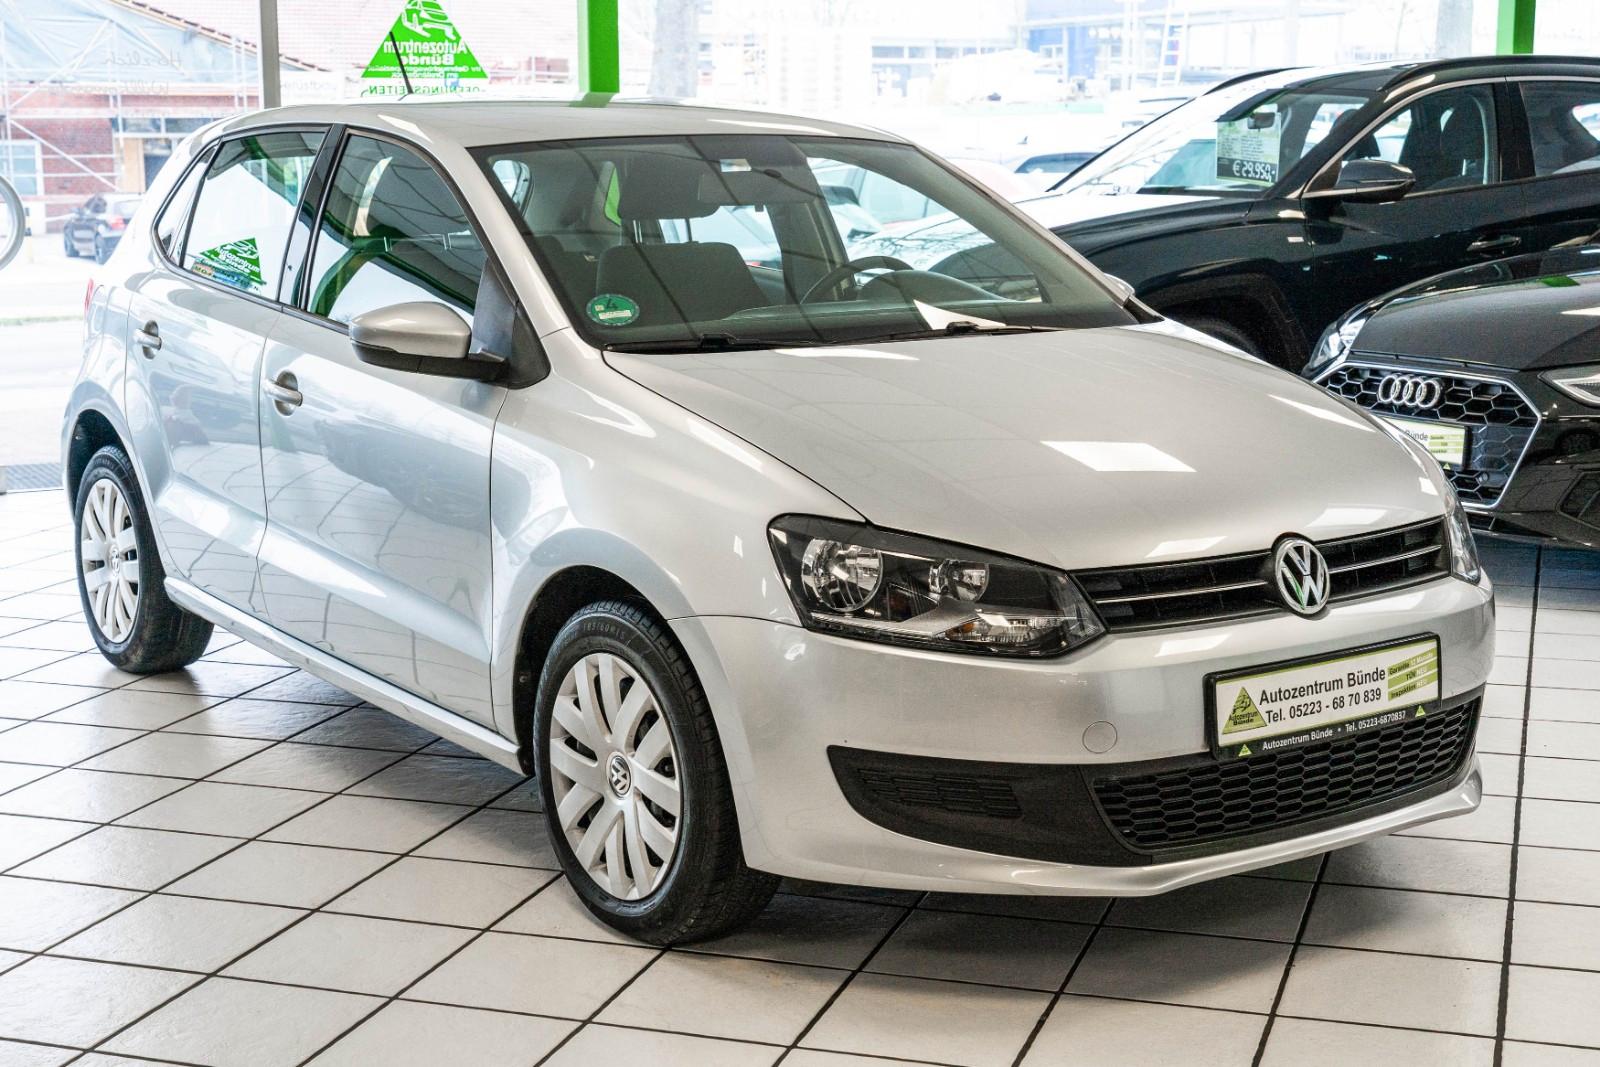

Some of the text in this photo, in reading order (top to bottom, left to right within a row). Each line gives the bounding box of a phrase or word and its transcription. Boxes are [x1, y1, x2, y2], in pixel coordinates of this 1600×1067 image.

[1259, 667, 1386, 705] Autozentrum Bünde
[1265, 707, 1286, 724] Tel.
[1289, 701, 1322, 719] 05223
[1332, 697, 1345, 710] 68
[1348, 692, 1361, 706] 70
[1363, 687, 1382, 702] 839
[1262, 711, 1406, 751] Autozentrum Bünde Tel. 05223-6870837
